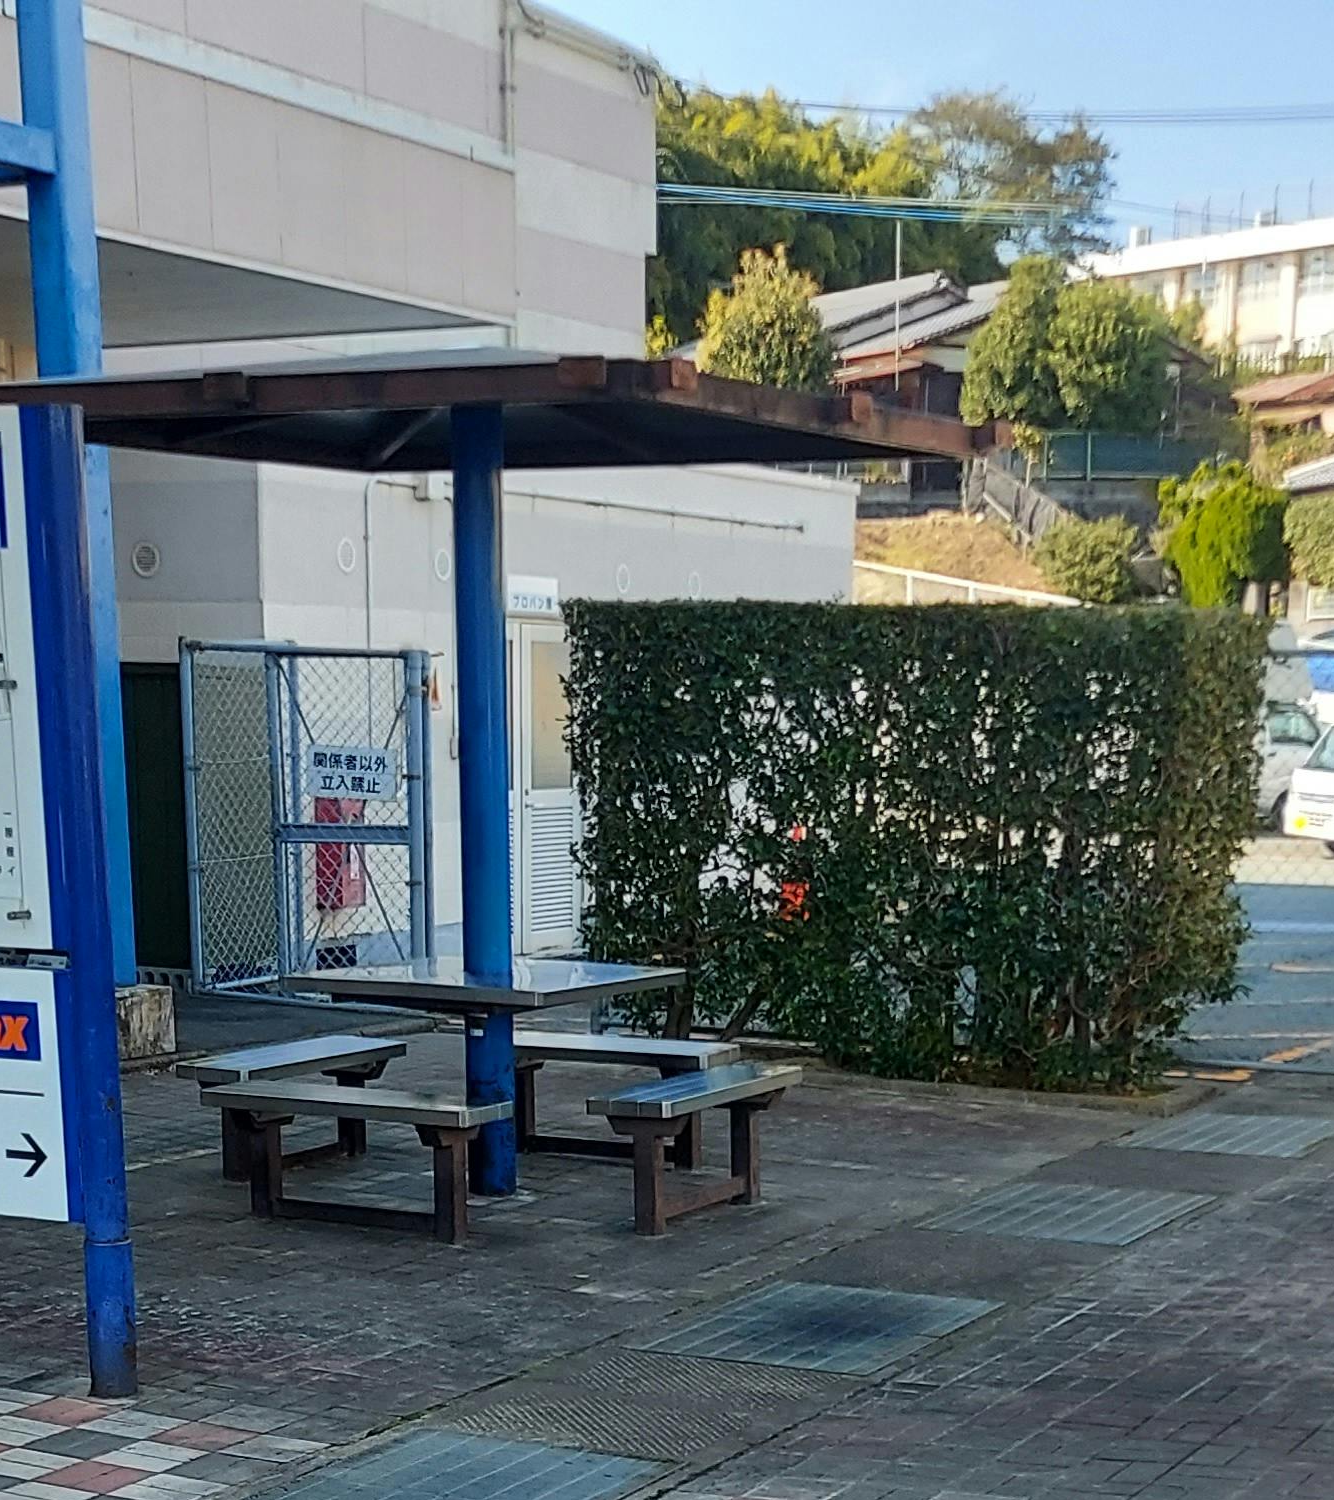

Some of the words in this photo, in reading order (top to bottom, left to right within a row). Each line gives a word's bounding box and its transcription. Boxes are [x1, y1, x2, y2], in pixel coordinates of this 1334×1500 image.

[313, 752, 388, 774] 関係者以外
[320, 775, 382, 794] 立入禁止
